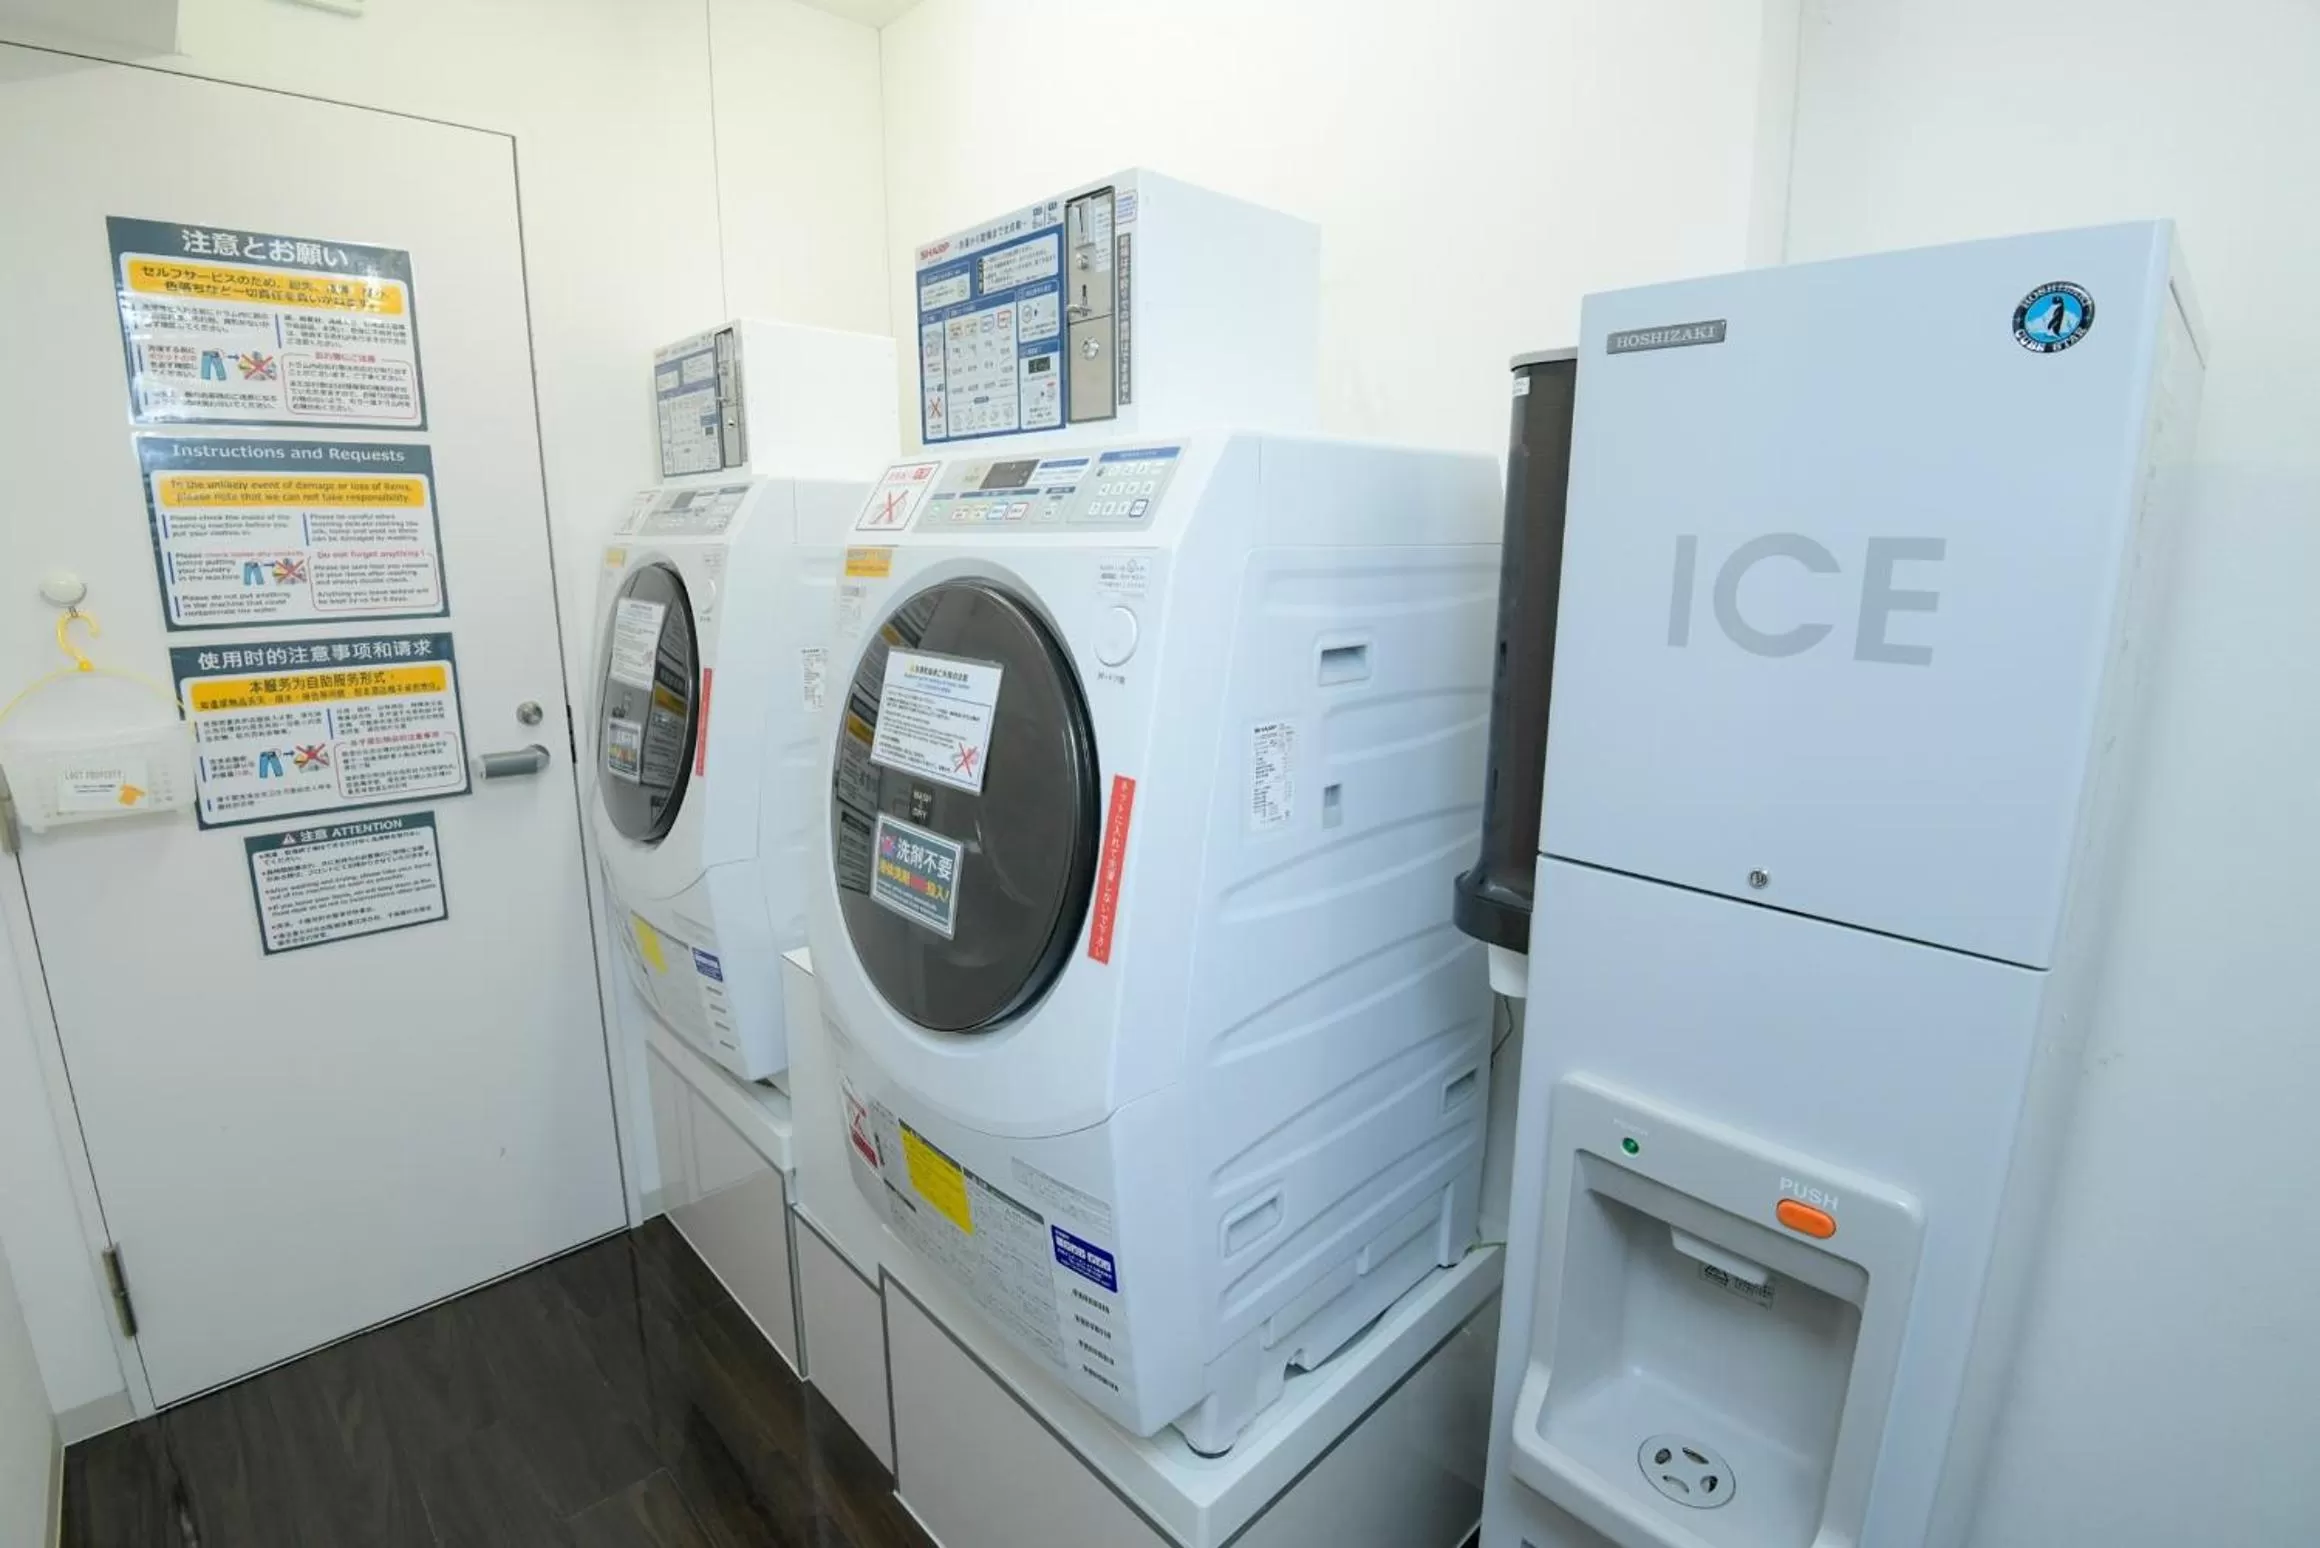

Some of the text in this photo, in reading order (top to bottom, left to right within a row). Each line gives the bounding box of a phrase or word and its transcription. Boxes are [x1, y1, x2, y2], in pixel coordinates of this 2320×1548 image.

[180, 228, 347, 267] 注意とお願い
[1617, 325, 1715, 349] HOSHIZAKI
[171, 443, 405, 463] Instructions and Requests
[204, 479, 248, 489] unlikely
[250, 480, 280, 490] event
[281, 480, 293, 490] of
[294, 480, 335, 490] damage
[335, 481, 348, 490] or
[370, 481, 381, 490] of
[1668, 532, 1947, 666] ICE
[196, 637, 431, 670] 使用时的注意事项和请求
[913, 790, 932, 803] WASH
[911, 807, 929, 820] DRY
[299, 817, 403, 842] 注意 ATTENTION
[897, 836, 954, 882] 洗剤不要
[1780, 1176, 1839, 1211] PUSH
